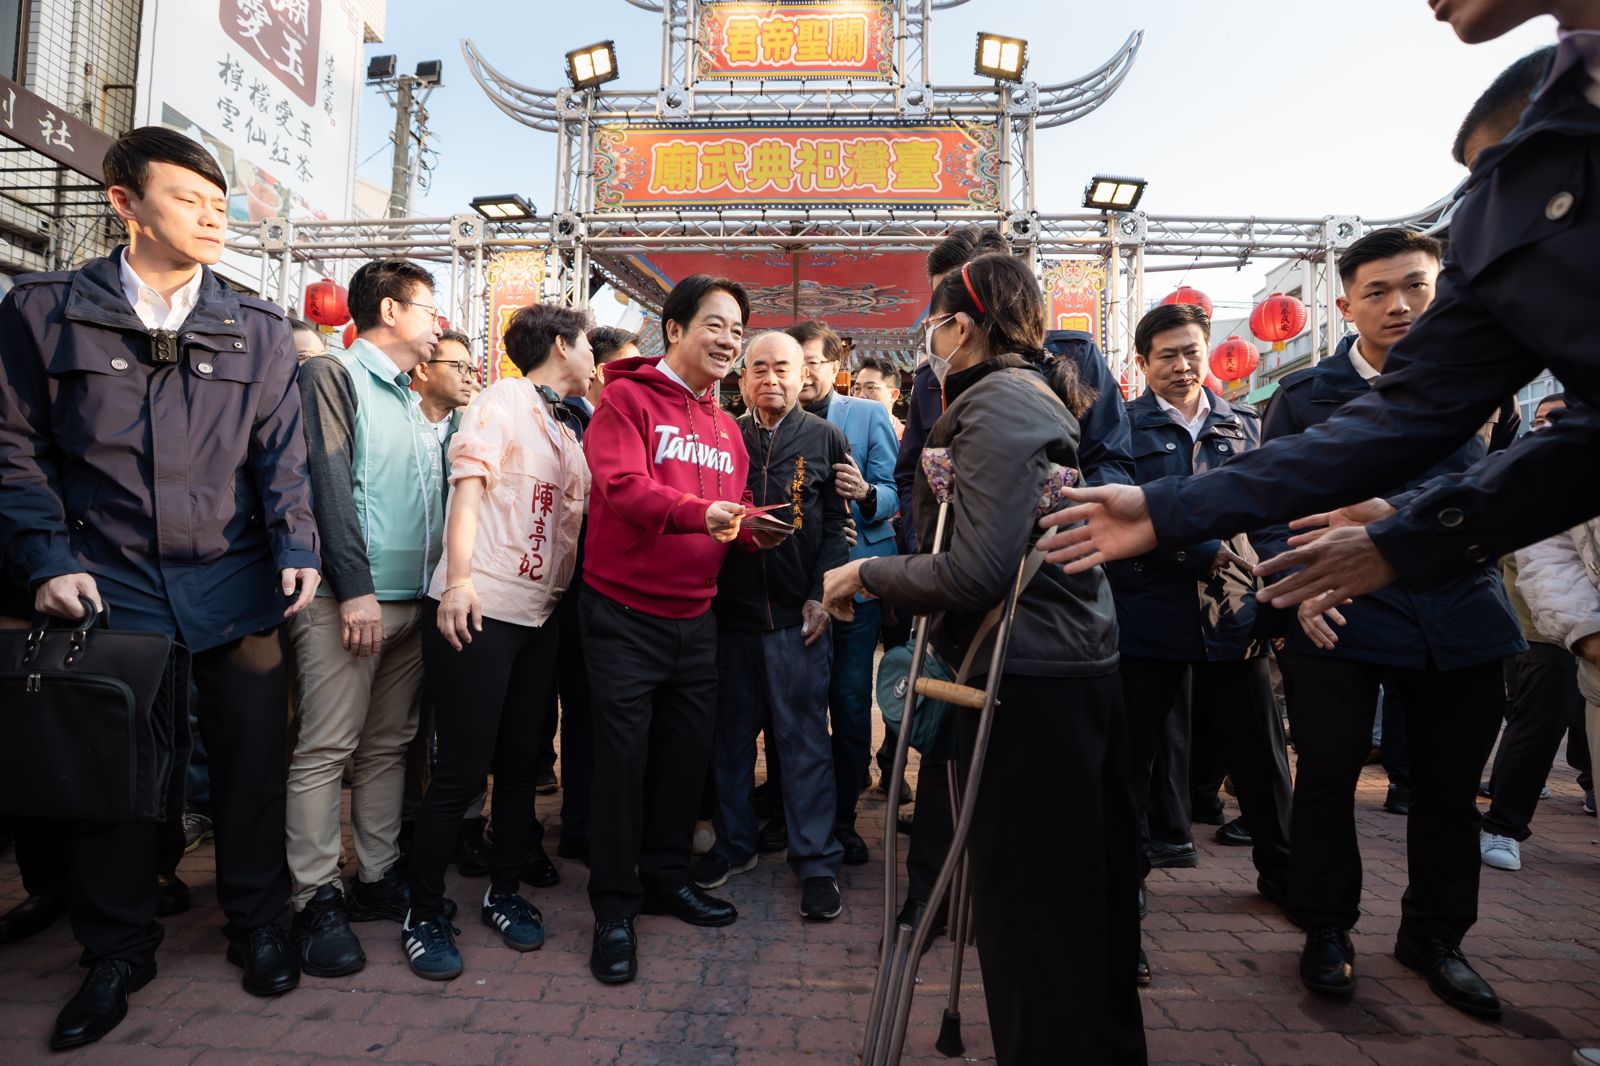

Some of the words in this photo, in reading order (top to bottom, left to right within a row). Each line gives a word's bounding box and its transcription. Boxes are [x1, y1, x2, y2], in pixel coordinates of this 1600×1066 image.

[217, 53, 312, 148] 檸檬愛玉
[217, 96, 314, 182] 雲仙紅茶
[654, 425, 734, 475] Taiwan
[518, 482, 554, 581] 陳亭妃
